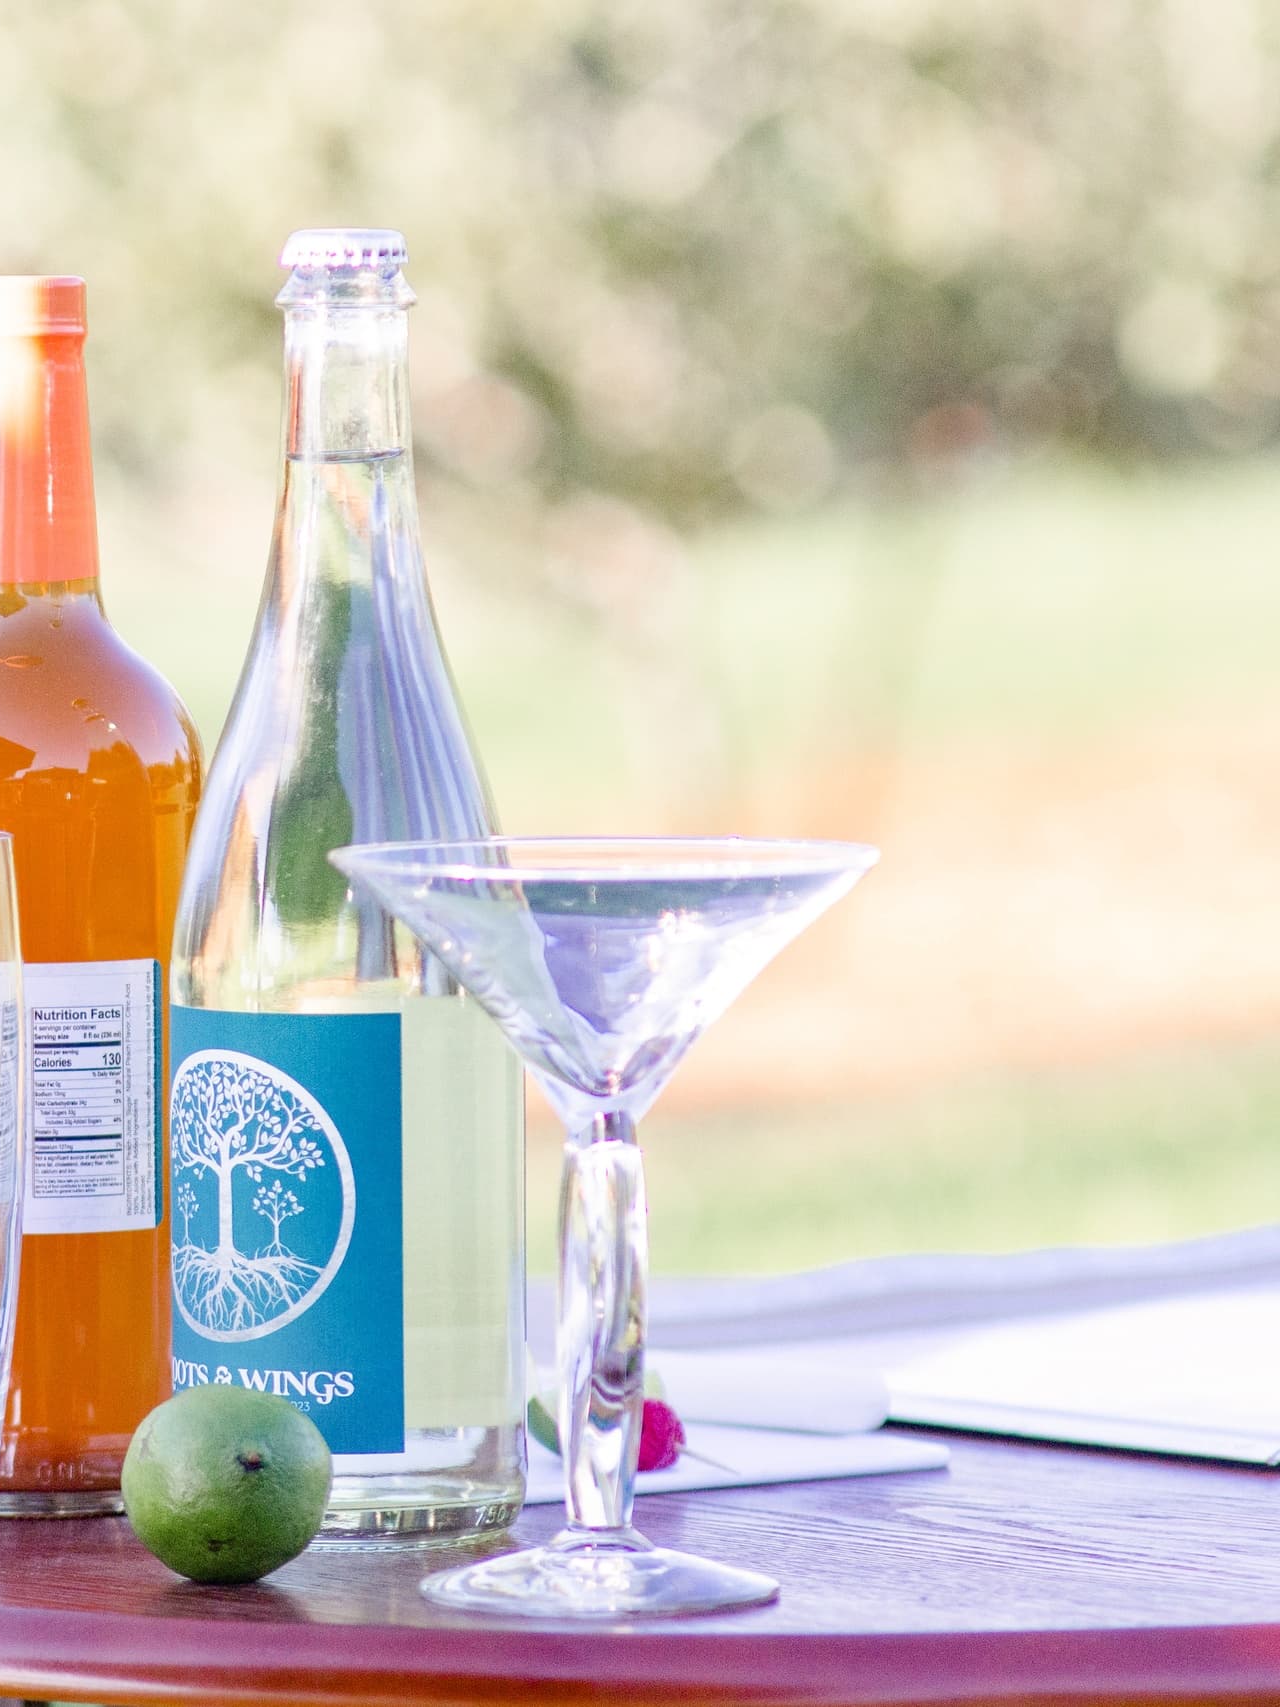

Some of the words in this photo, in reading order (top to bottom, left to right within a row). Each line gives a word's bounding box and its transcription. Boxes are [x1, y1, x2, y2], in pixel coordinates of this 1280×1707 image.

[34, 1009, 87, 1021] Nutrition
[91, 1008, 121, 1020] Facts
[34, 1057, 72, 1068] Calories
[102, 1052, 122, 1066] 130
[172, 1356, 209, 1387] OOTS
[214, 1366, 233, 1385] &
[238, 1368, 355, 1405] WINGS
